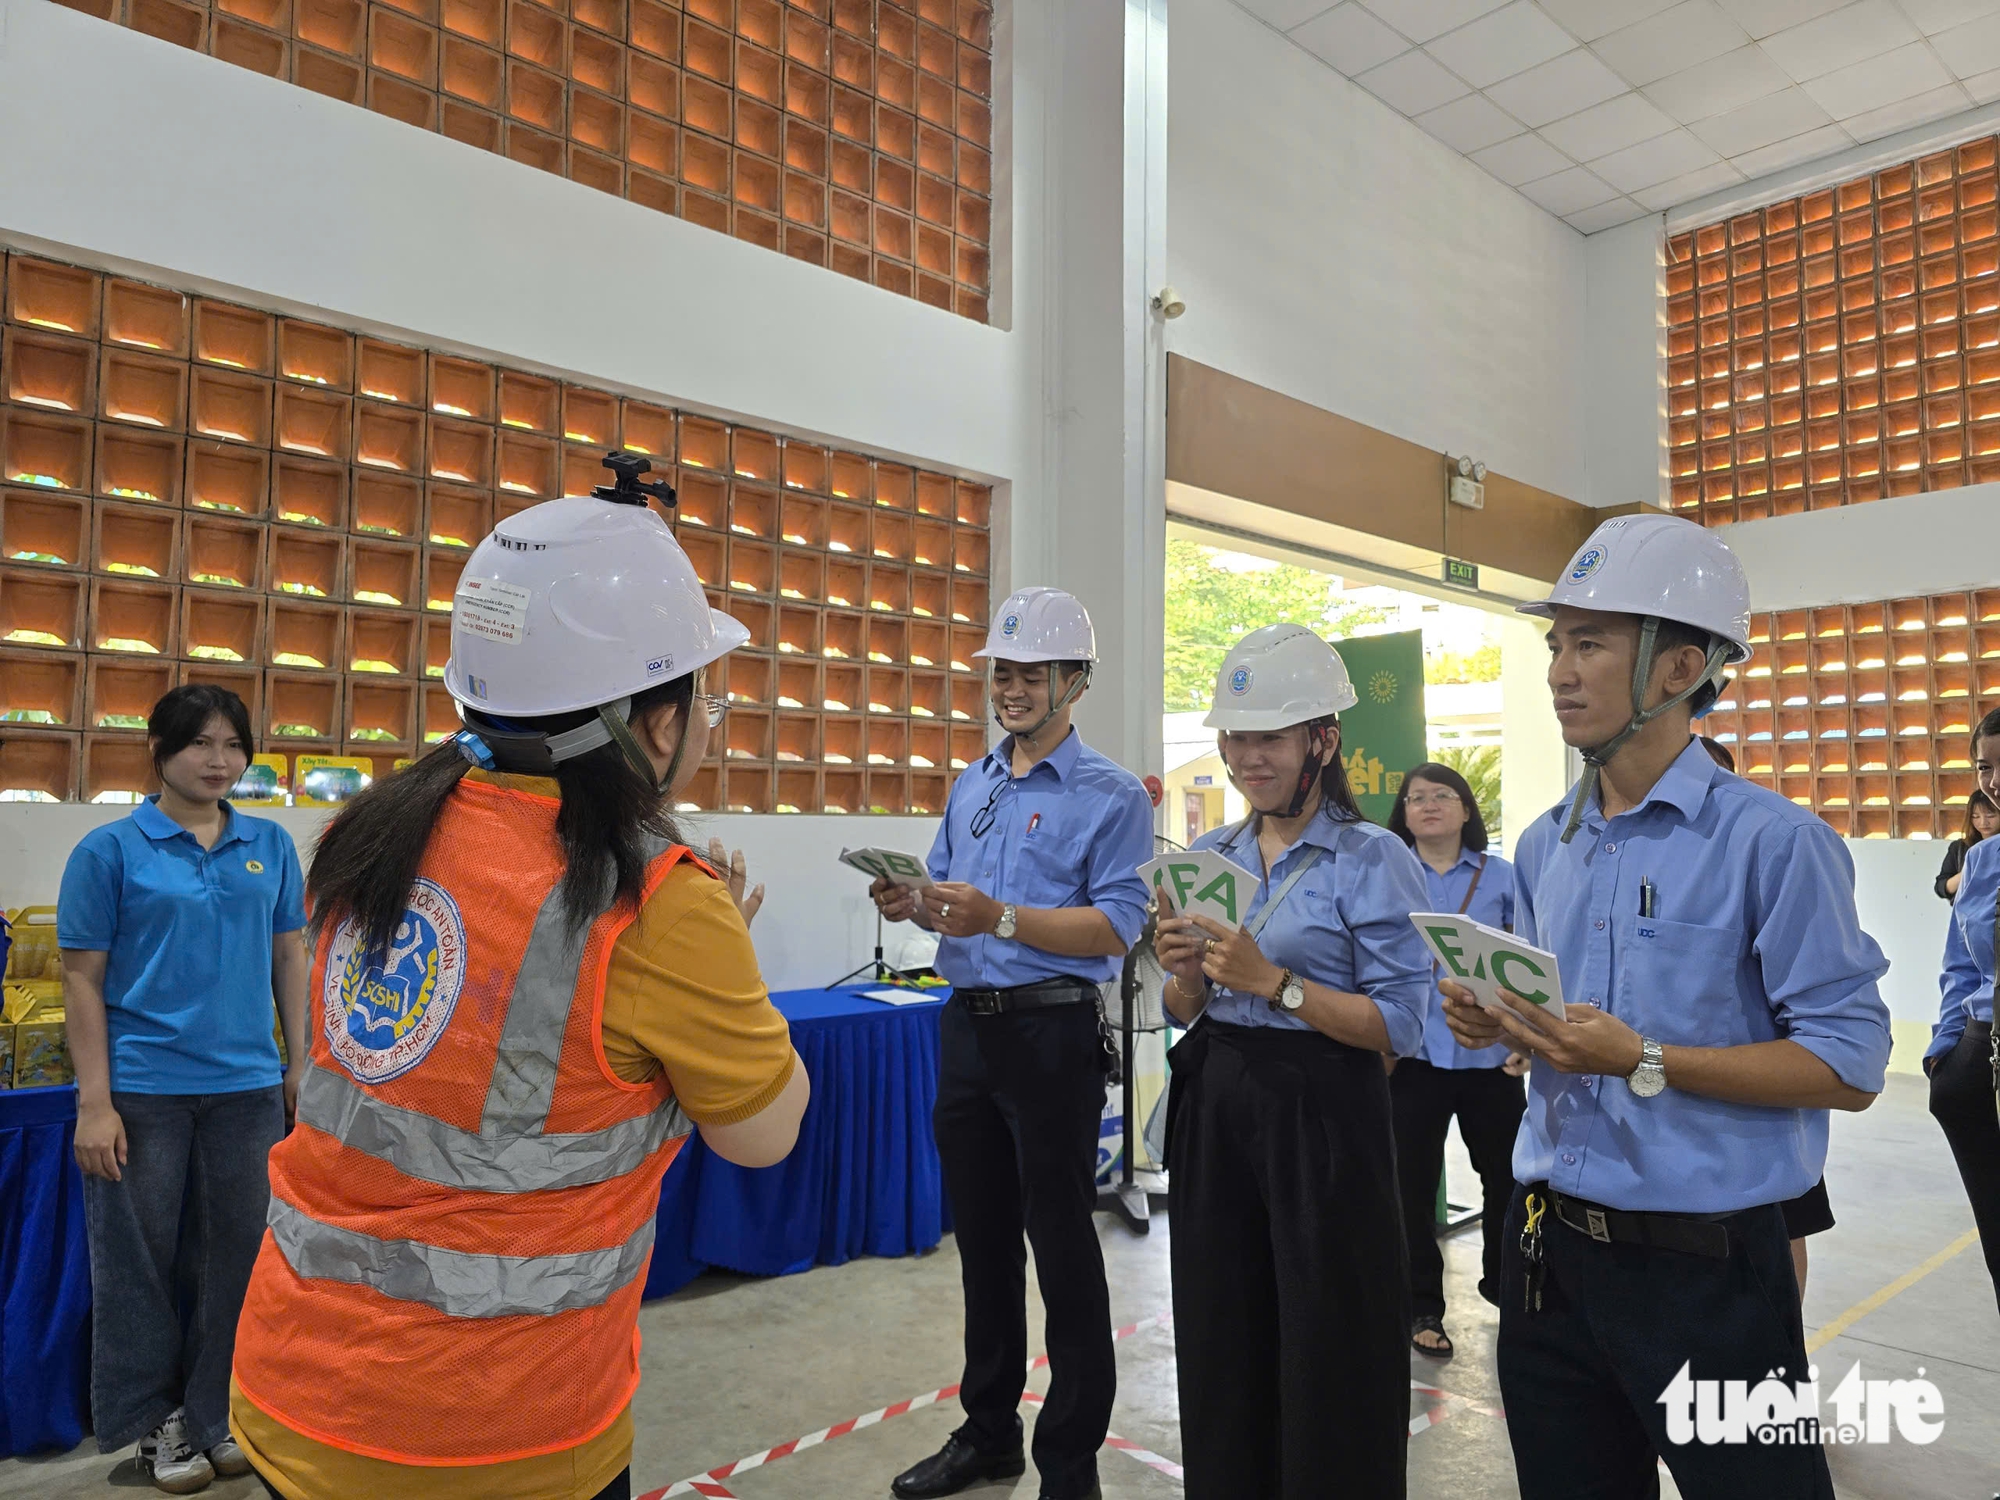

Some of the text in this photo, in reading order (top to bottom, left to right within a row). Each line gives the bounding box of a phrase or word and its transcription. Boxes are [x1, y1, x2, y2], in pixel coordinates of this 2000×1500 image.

[1450, 562, 1473, 579] EXIT
[881, 852, 922, 877] B
[1194, 870, 1238, 925] A
[431, 906, 448, 927] AN
[440, 924, 457, 971] TOÀN
[1425, 926, 1470, 978] E
[1637, 927, 1656, 939] UDC
[1490, 950, 1551, 1005] C
